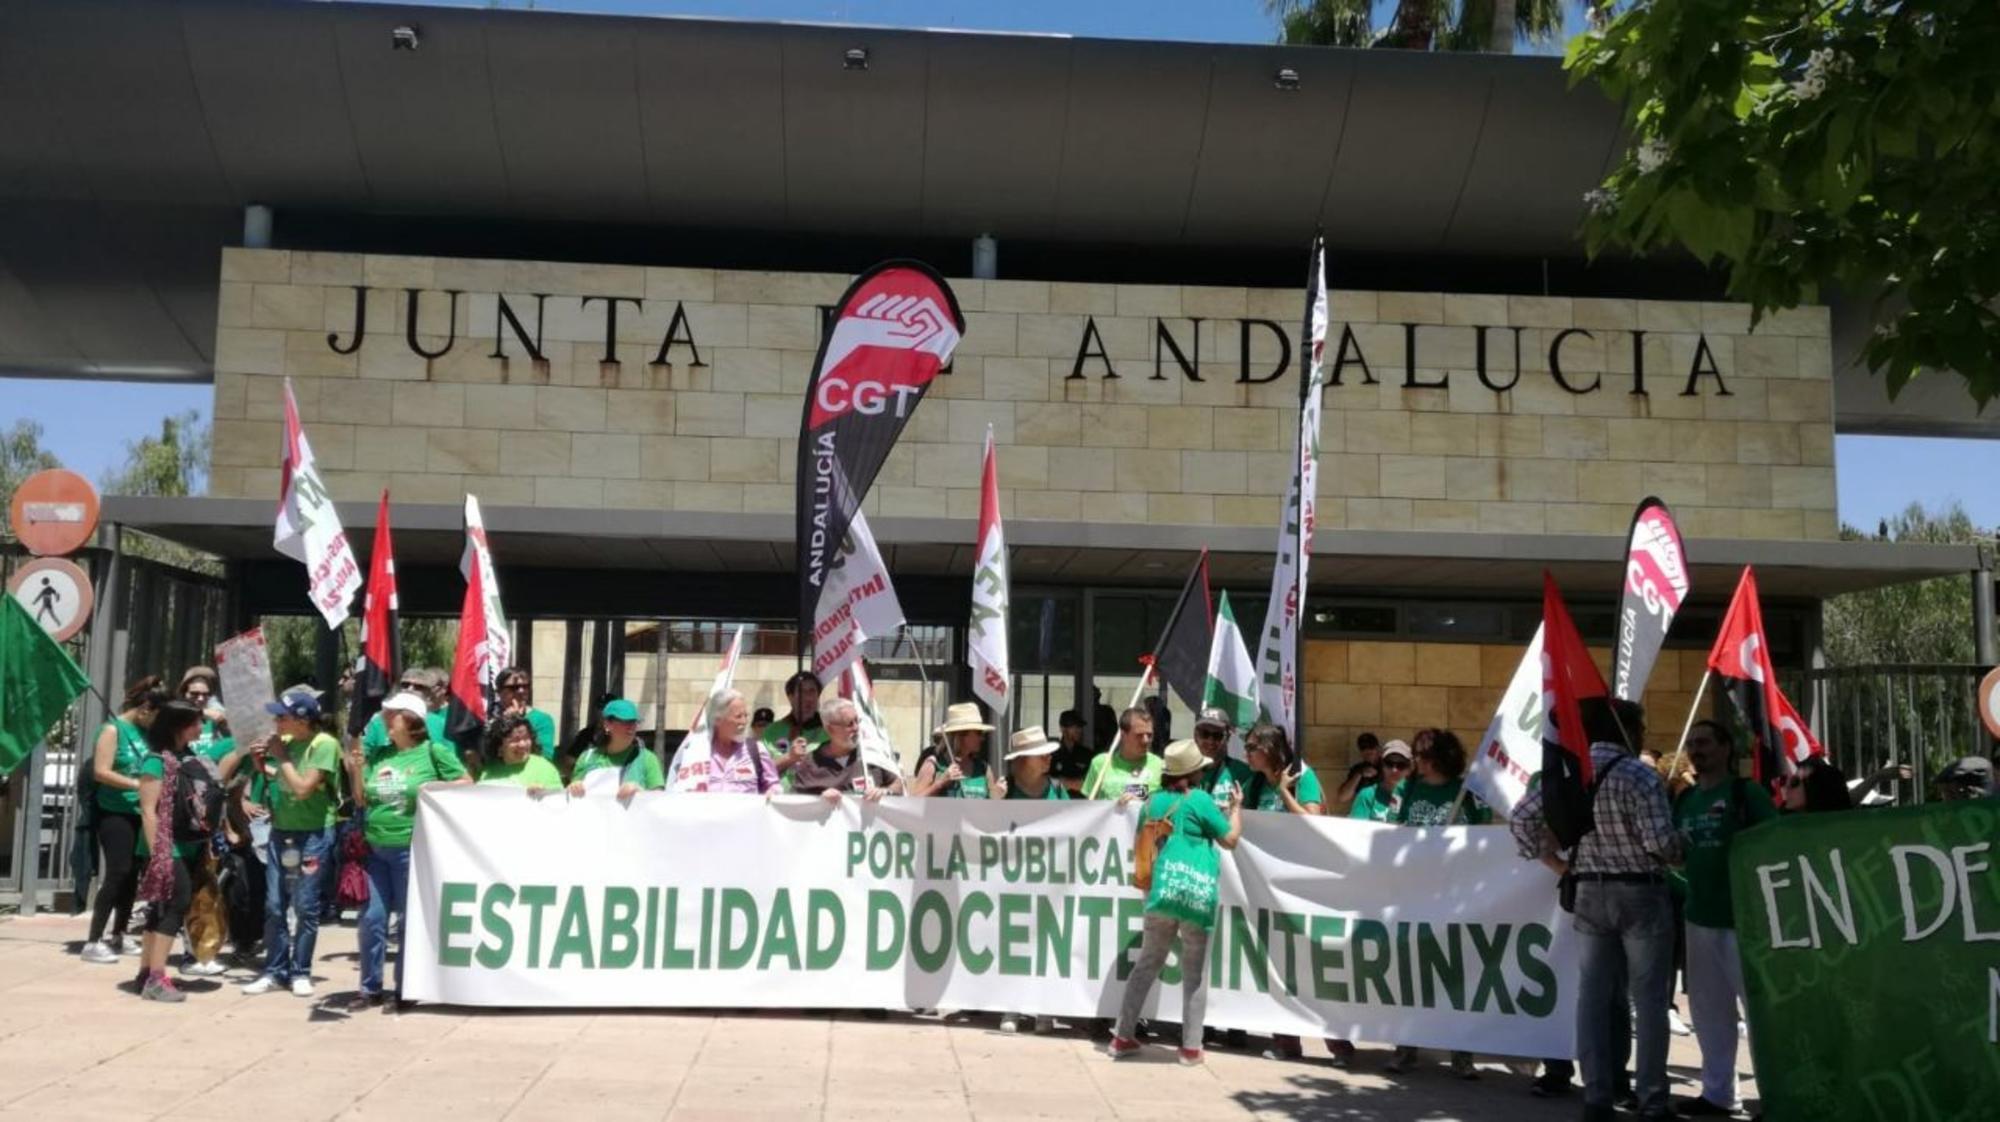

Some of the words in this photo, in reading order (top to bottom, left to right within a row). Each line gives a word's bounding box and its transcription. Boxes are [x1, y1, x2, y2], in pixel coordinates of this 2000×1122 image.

[327, 285, 708, 368] JUNTA
[1064, 315, 1734, 396] ANDALUCIA
[817, 378, 919, 417] CGT
[809, 431, 837, 587] ANDALUCÍA
[1627, 559, 1675, 635] CGT
[1615, 607, 1637, 701] DALUCÍA
[846, 832, 916, 880] POR
[926, 833, 969, 881] LA
[1757, 848, 1859, 949] EN
[438, 882, 846, 972] ESTABILIDAD
[1211, 905, 1558, 1019] INTERINXS
